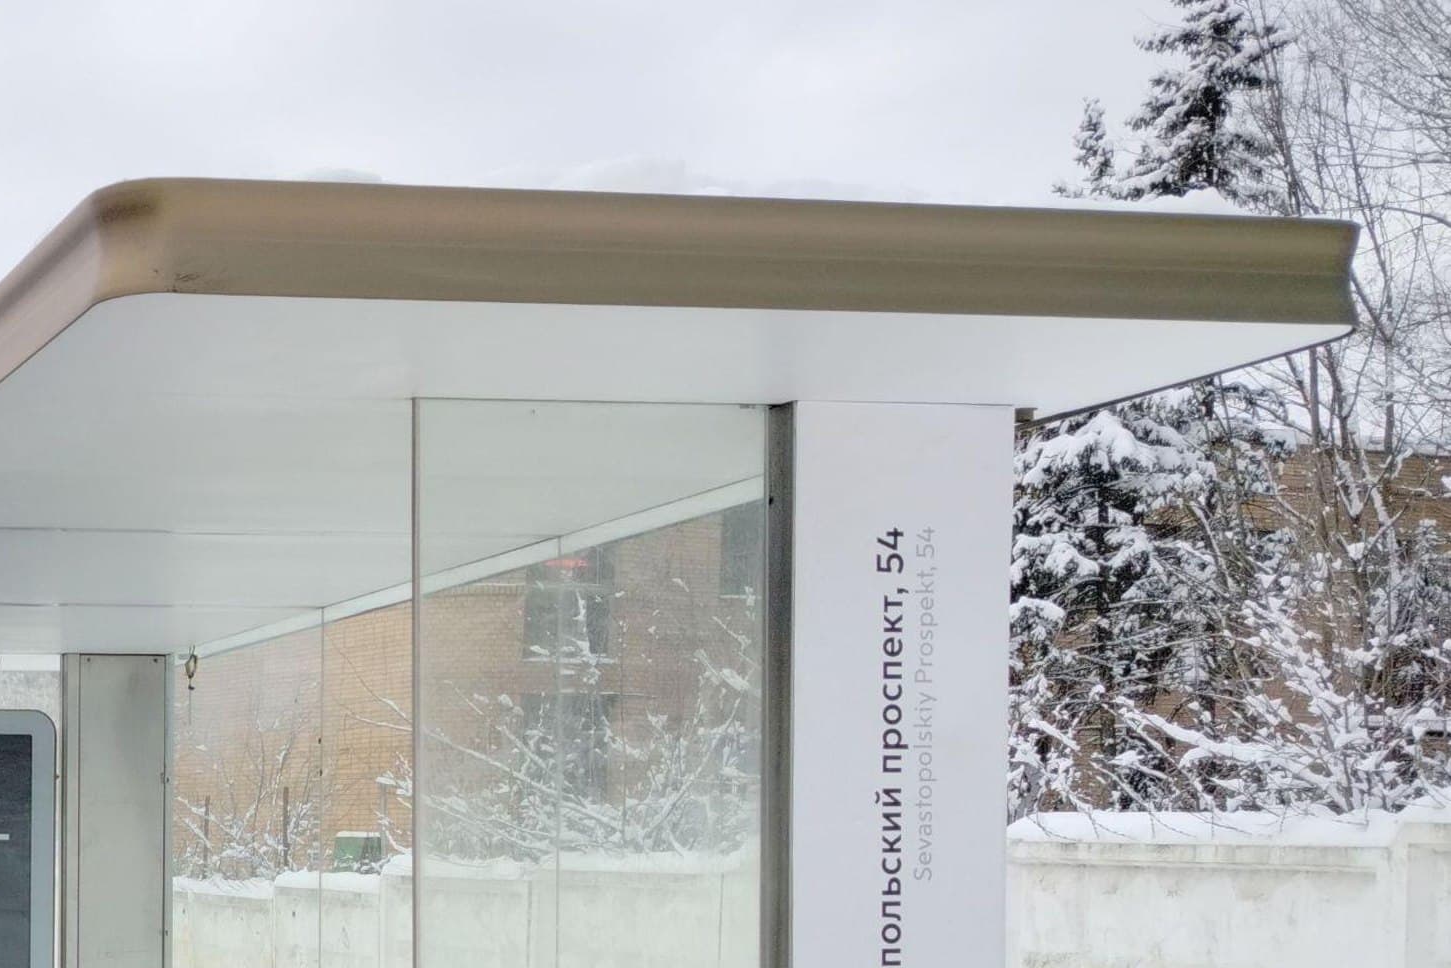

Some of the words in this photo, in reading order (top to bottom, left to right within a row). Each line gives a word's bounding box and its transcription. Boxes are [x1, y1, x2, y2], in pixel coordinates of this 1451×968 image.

[876, 528, 904, 574] 54
[916, 526, 935, 558] 54
[882, 587, 909, 773] проспект,
[915, 567, 938, 684] Prospekt,
[913, 692, 937, 881] Sevastopolskiy
